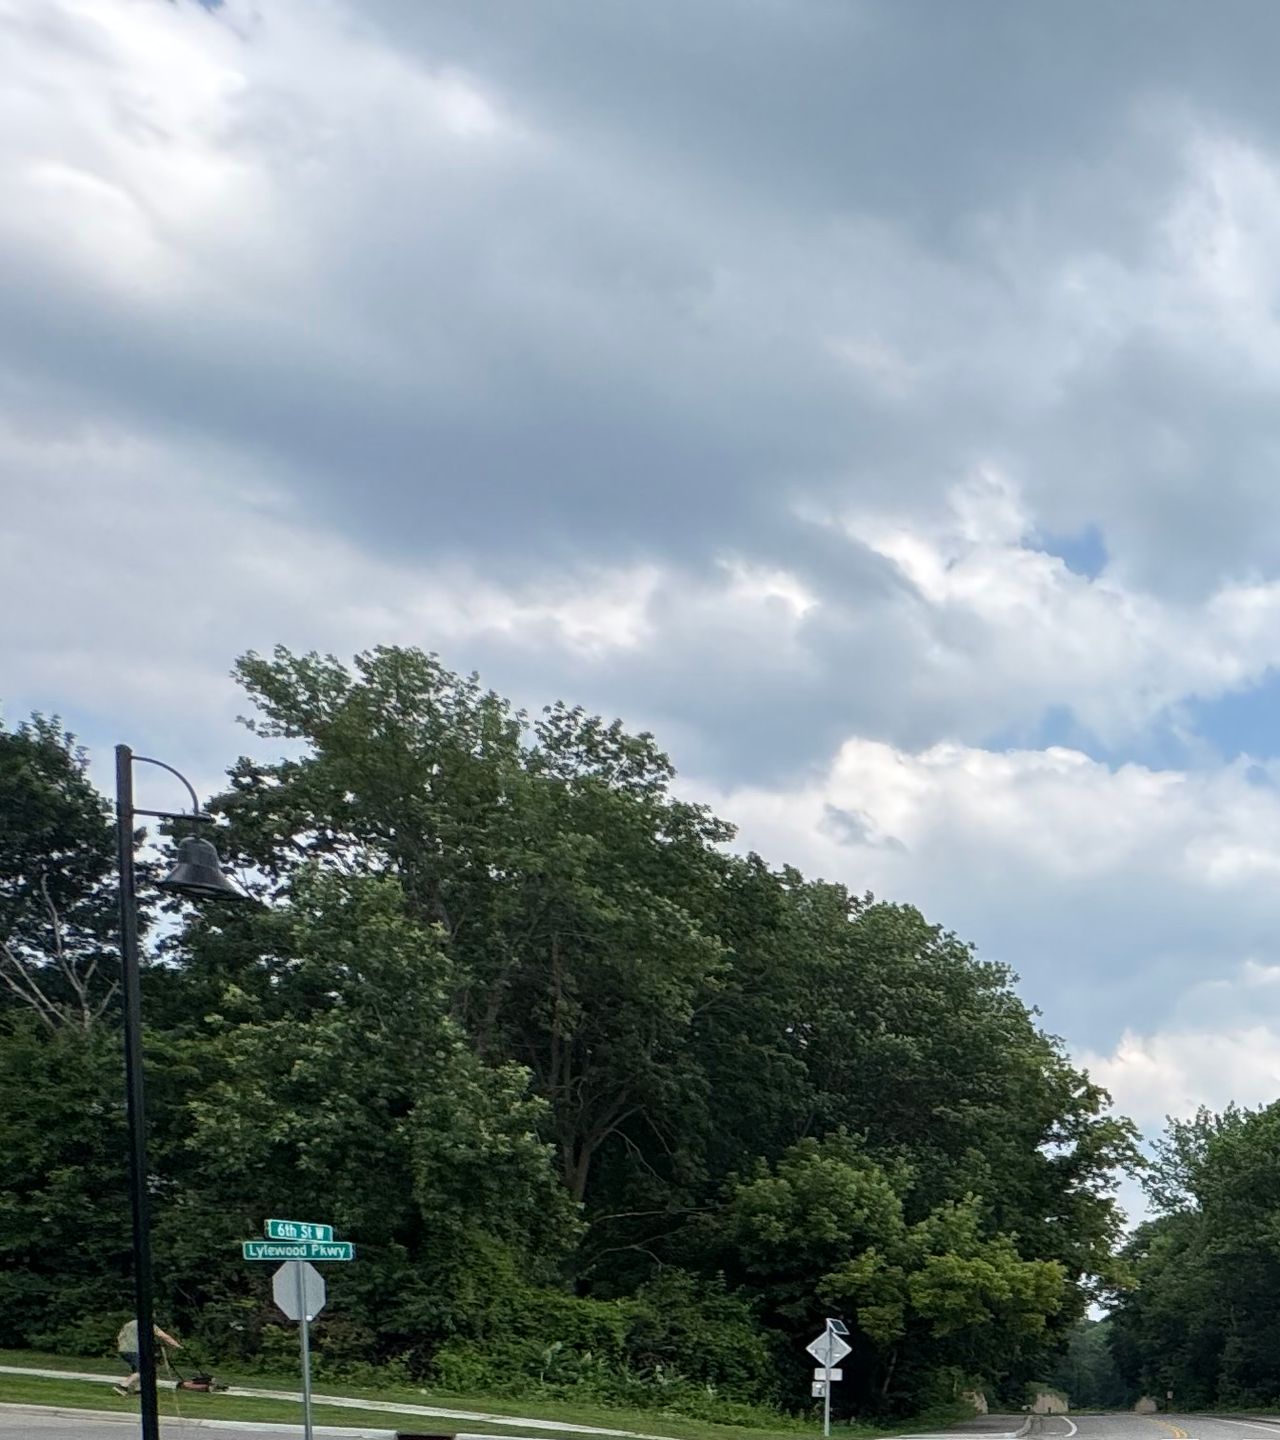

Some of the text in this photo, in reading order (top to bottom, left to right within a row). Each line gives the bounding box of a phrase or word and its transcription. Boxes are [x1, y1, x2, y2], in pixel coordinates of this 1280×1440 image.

[277, 1223, 325, 1239] 6th St W
[249, 1244, 346, 1259] Lylewood Pkwy
